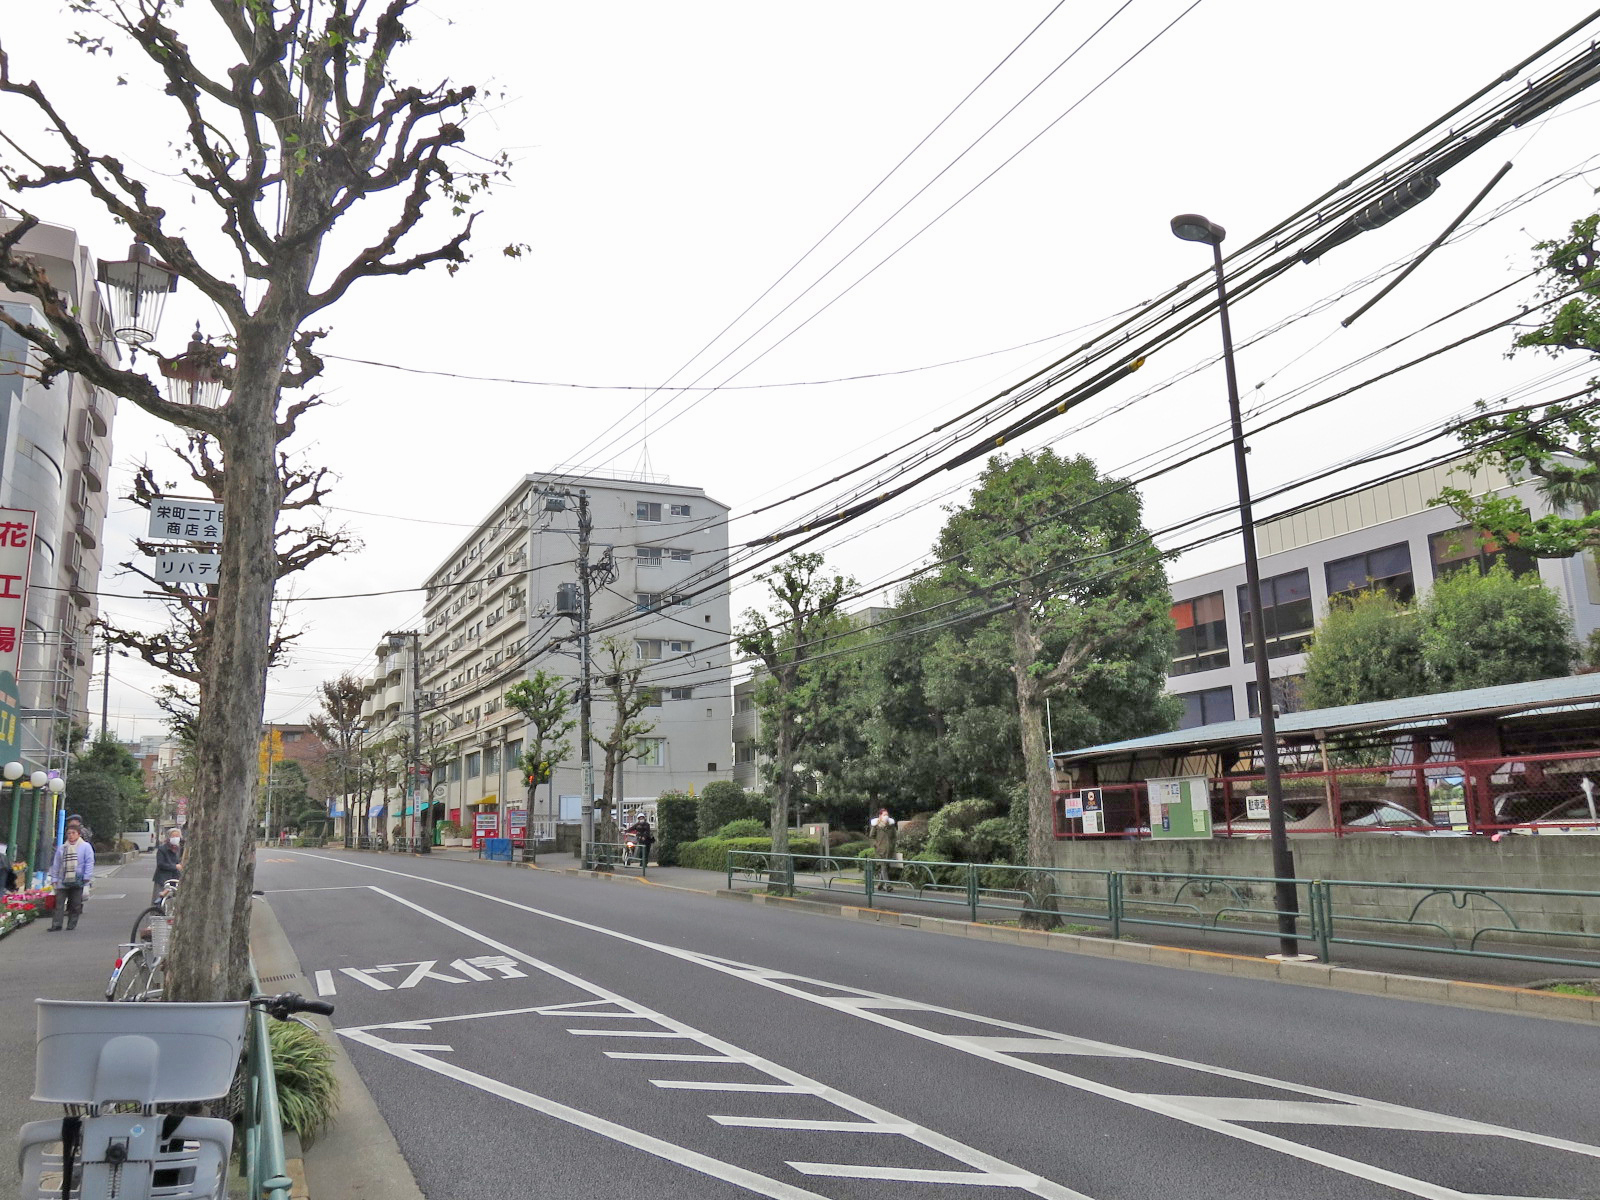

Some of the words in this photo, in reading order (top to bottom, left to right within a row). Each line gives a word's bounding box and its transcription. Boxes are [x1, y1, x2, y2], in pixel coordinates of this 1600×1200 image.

[166, 522, 218, 538] 商店会
[162, 561, 221, 575] リバテ
[314, 955, 529, 997] バス停
